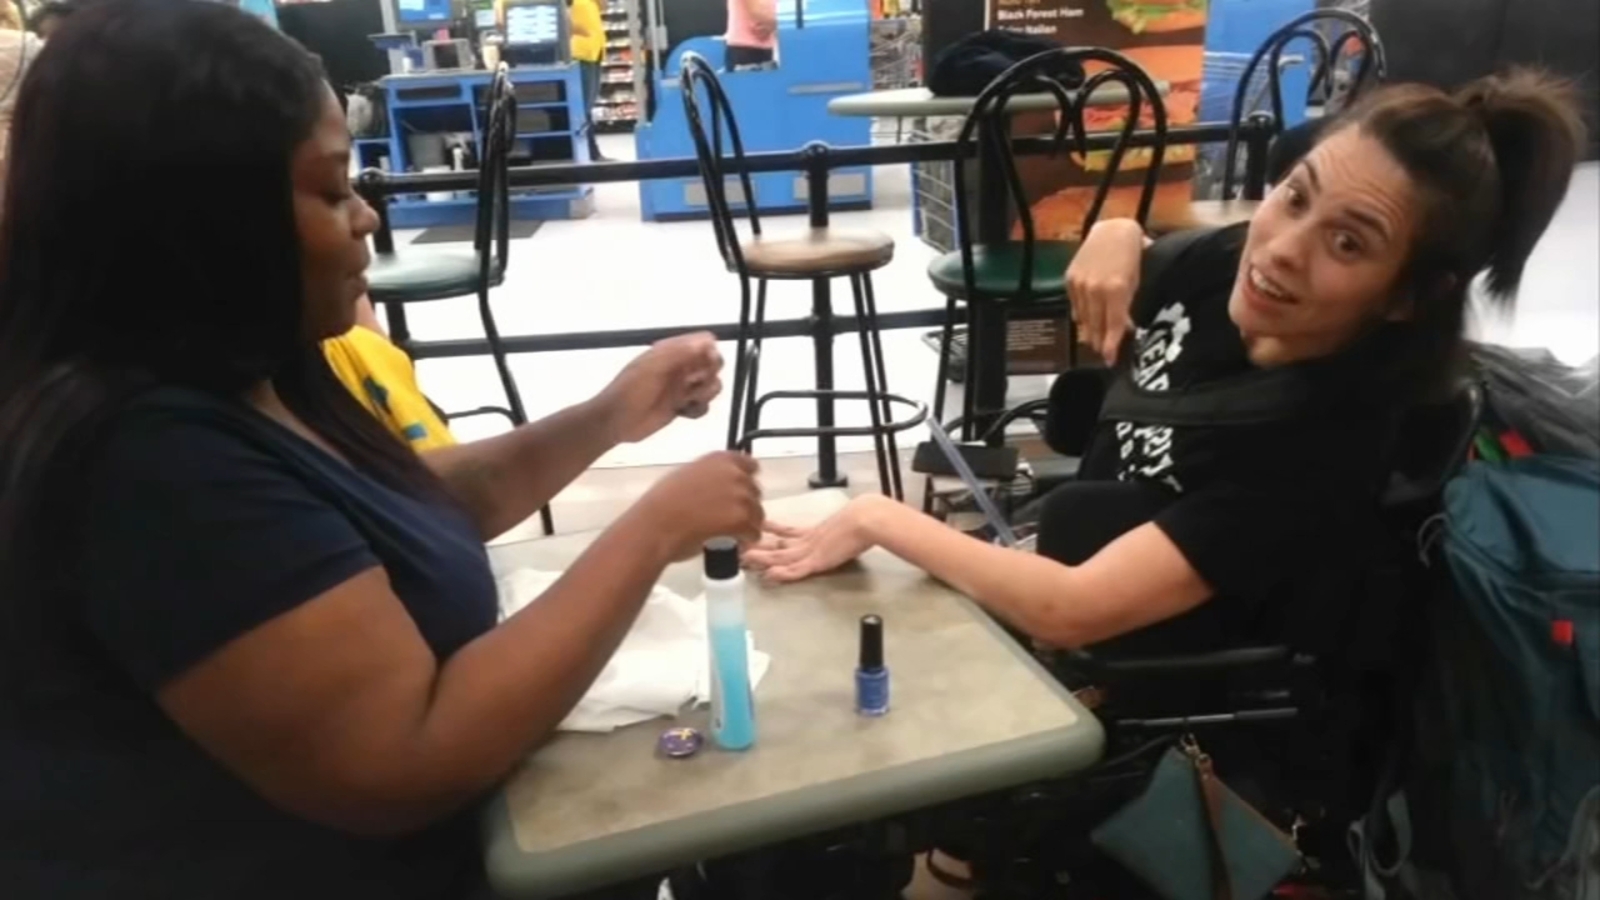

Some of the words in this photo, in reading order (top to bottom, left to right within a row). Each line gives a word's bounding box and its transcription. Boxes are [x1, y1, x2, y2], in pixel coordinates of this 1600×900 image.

[998, 9, 1024, 20] Black
[1026, 9, 1057, 19] Forest
[1060, 8, 1084, 18] Ham
[1025, 24, 1057, 34] Italian
